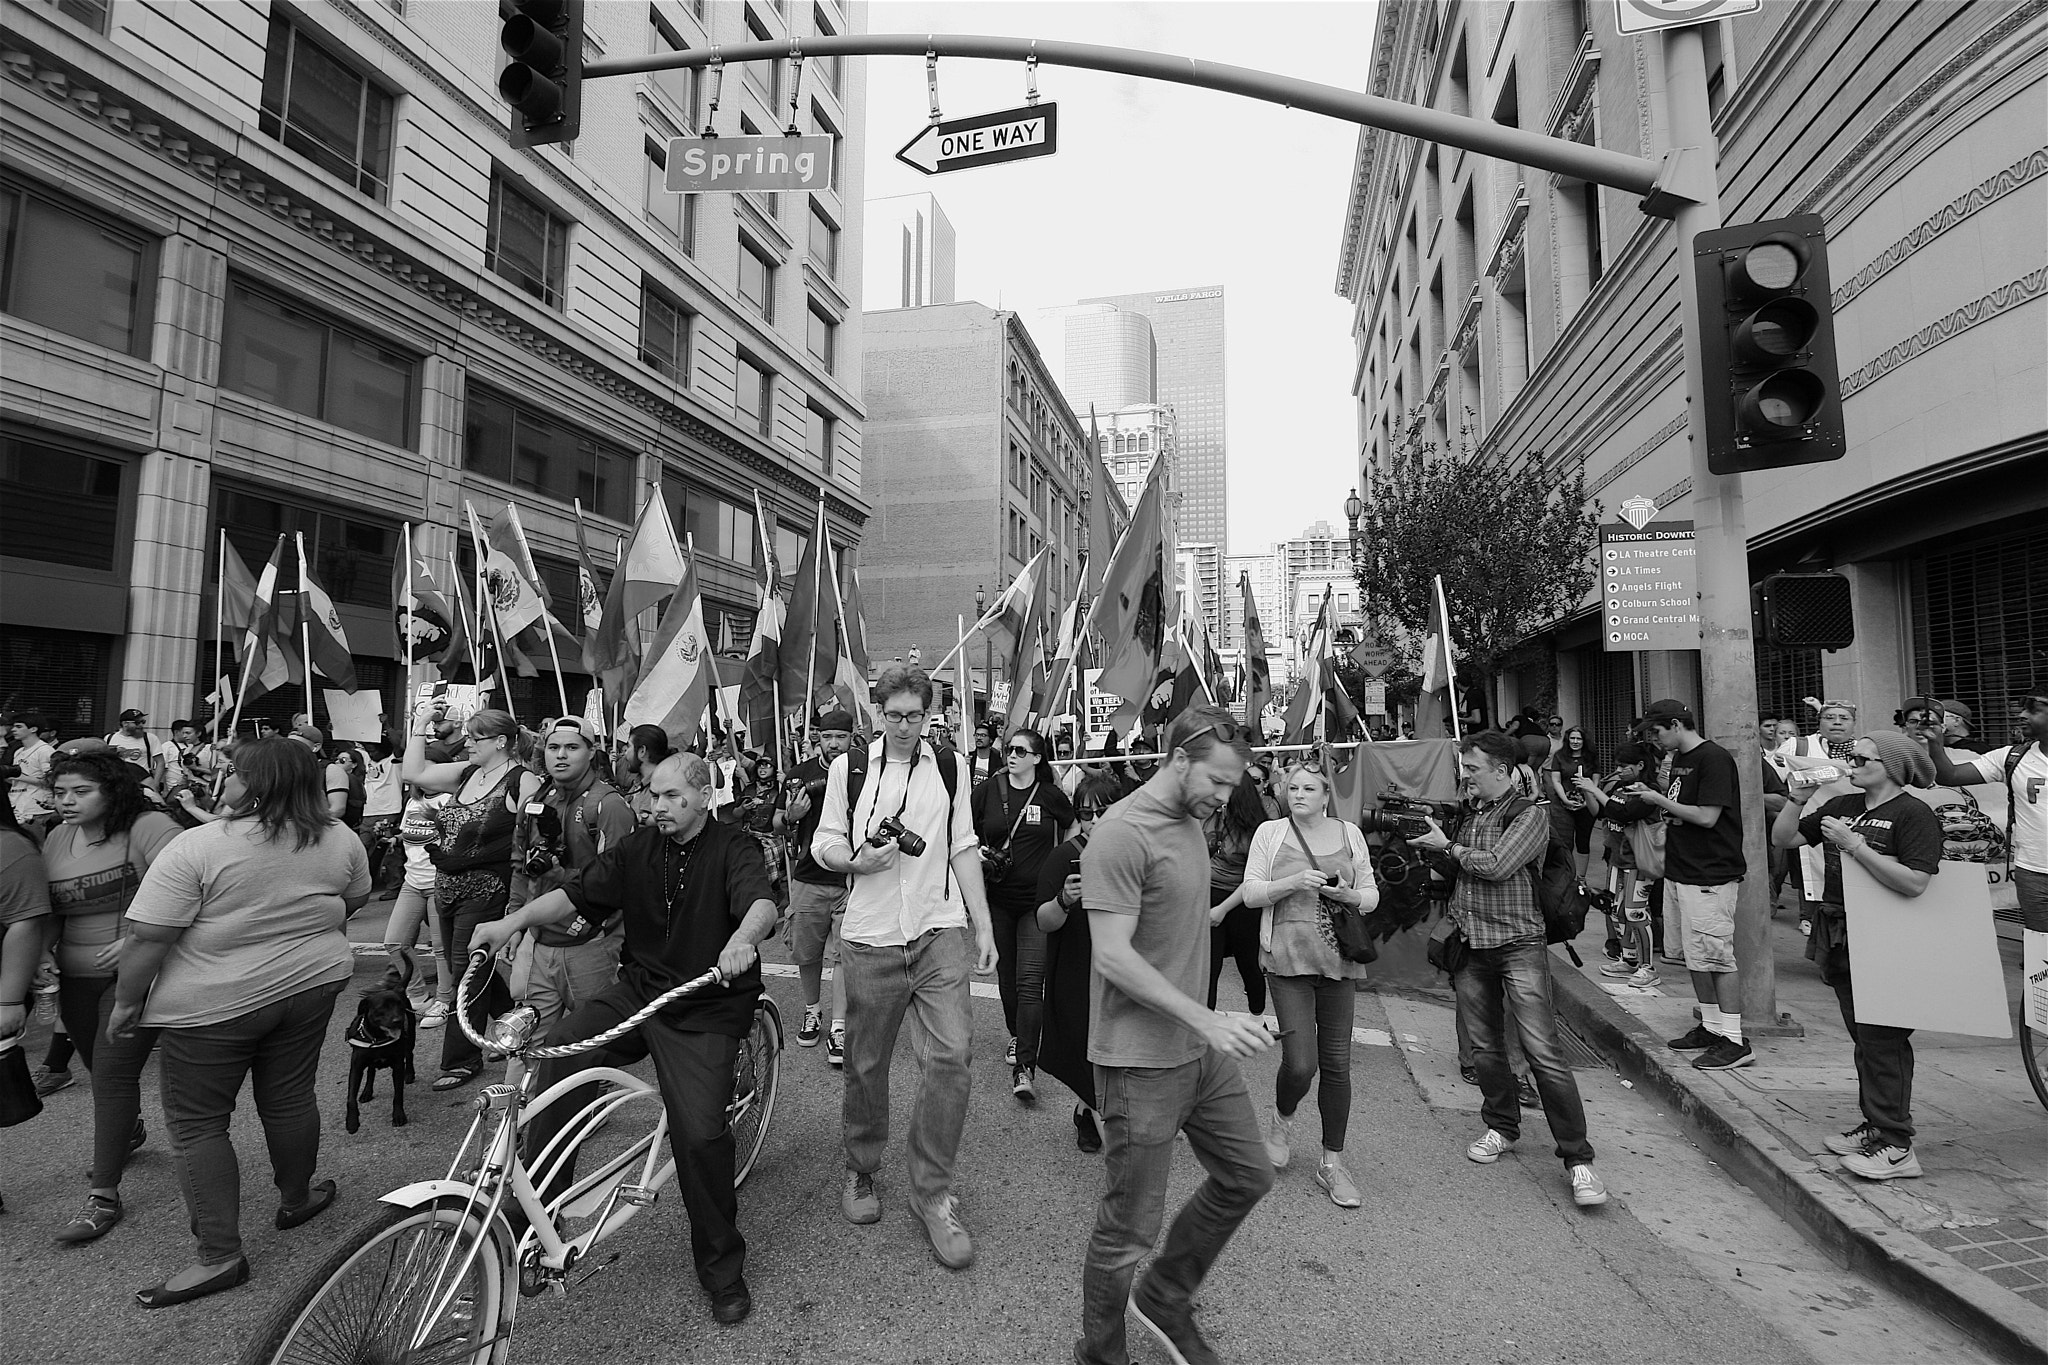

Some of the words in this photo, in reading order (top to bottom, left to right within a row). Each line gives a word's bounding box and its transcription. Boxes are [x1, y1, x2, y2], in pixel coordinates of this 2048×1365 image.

[941, 126, 984, 157] ONE
[993, 121, 1039, 148] WAY
[682, 147, 816, 183] Spring
[1154, 293, 1188, 303] WELLS
[1189, 290, 1222, 300] FARGO
[1607, 533, 1652, 541] HISTORIC
[1619, 551, 1630, 559] LA
[1634, 549, 1669, 558] Theatre
[1620, 567, 1631, 575] LA
[1634, 566, 1661, 574] Times
[1621, 583, 1652, 592] Angels
[1655, 581, 1682, 591] Flight
[1622, 599, 1657, 608] Colburn
[1660, 598, 1691, 607] School
[1623, 616, 1649, 624] Grand
[1652, 615, 1686, 624] Central
[1623, 632, 1649, 641] MOCA
[566, 914, 587, 937] USC
